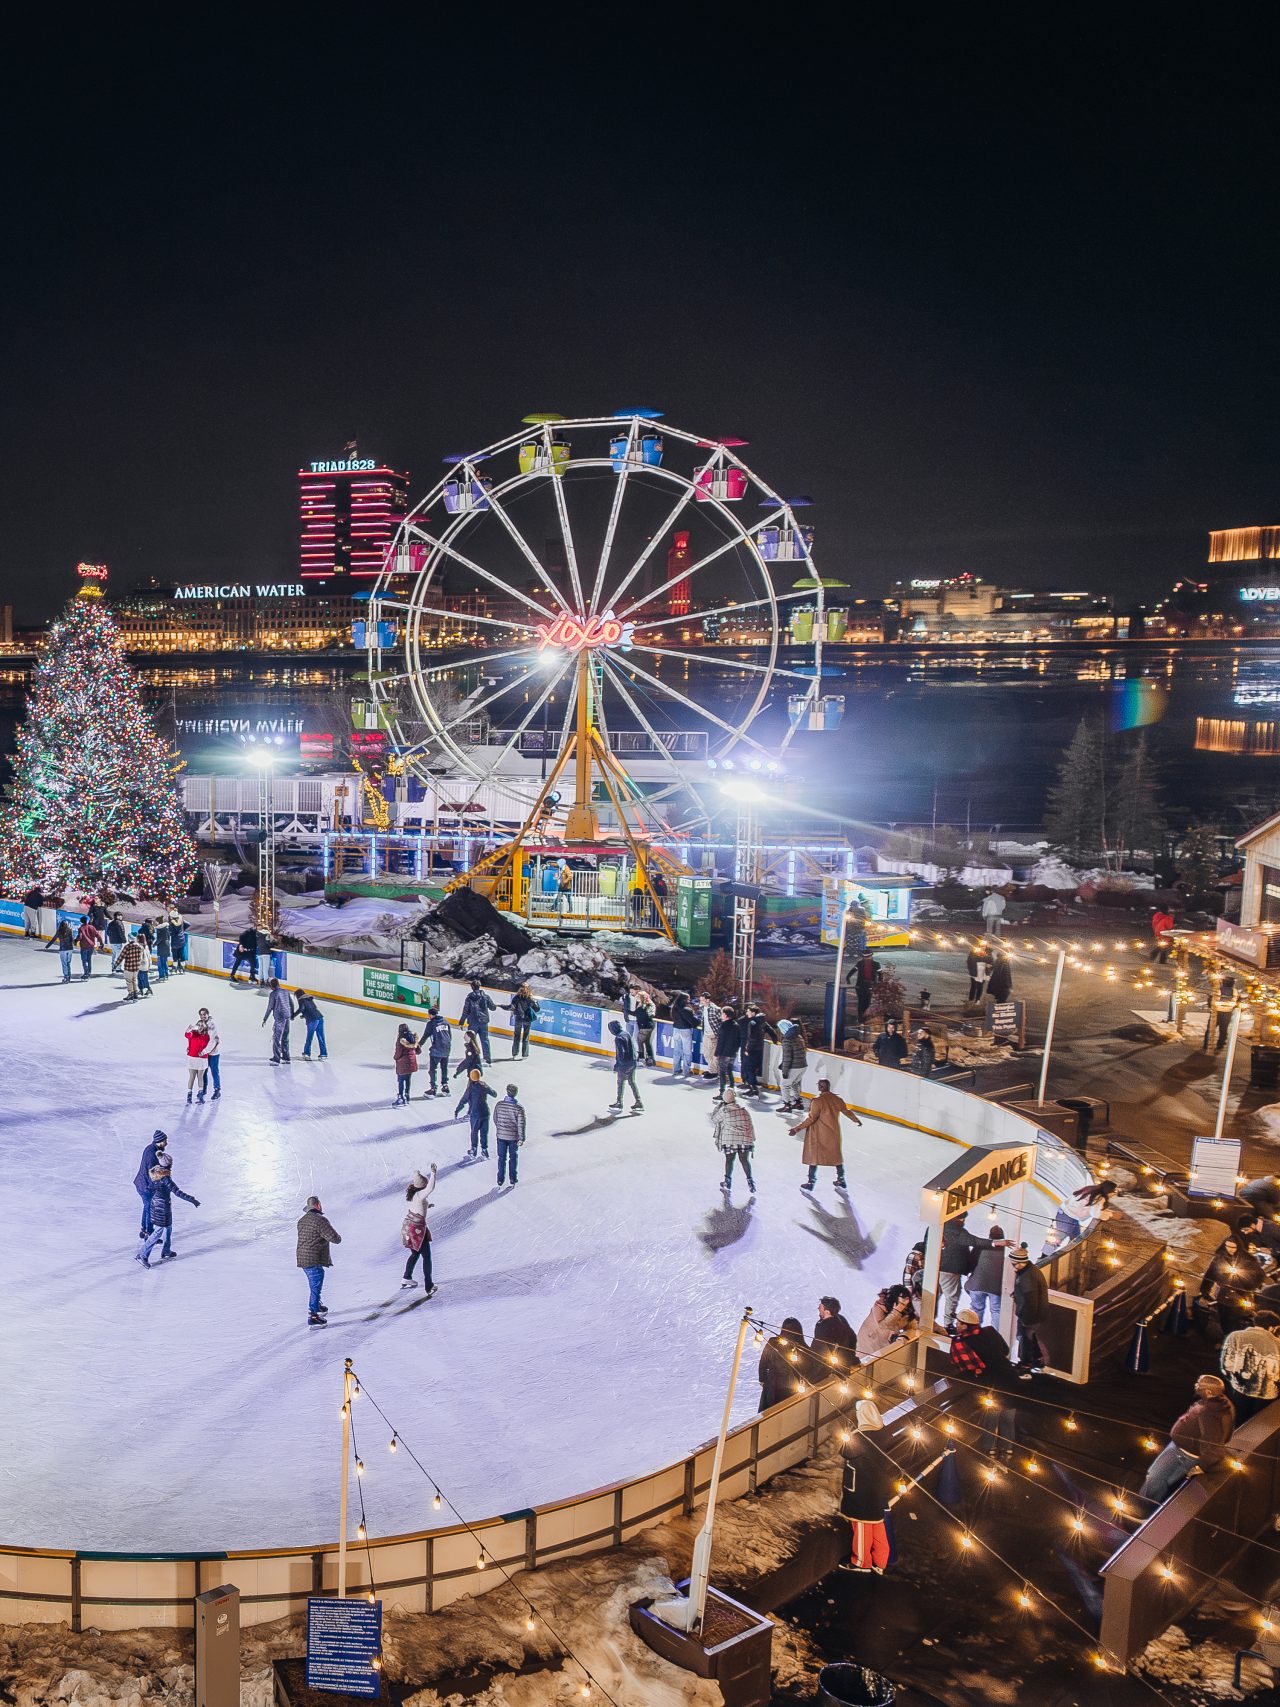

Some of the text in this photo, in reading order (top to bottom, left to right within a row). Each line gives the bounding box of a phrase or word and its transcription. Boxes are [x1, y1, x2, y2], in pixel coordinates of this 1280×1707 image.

[311, 459, 375, 473] TRIAD1828
[174, 584, 306, 599] AMERICAN WATER
[371, 971, 389, 982] SHARE
[365, 979, 395, 991] THE SPIRIT
[366, 988, 394, 1000] DE TODOS
[560, 1007, 583, 1018] Follow
[583, 1012, 595, 1021] Us!
[946, 1152, 1028, 1215] ENTRANCE
